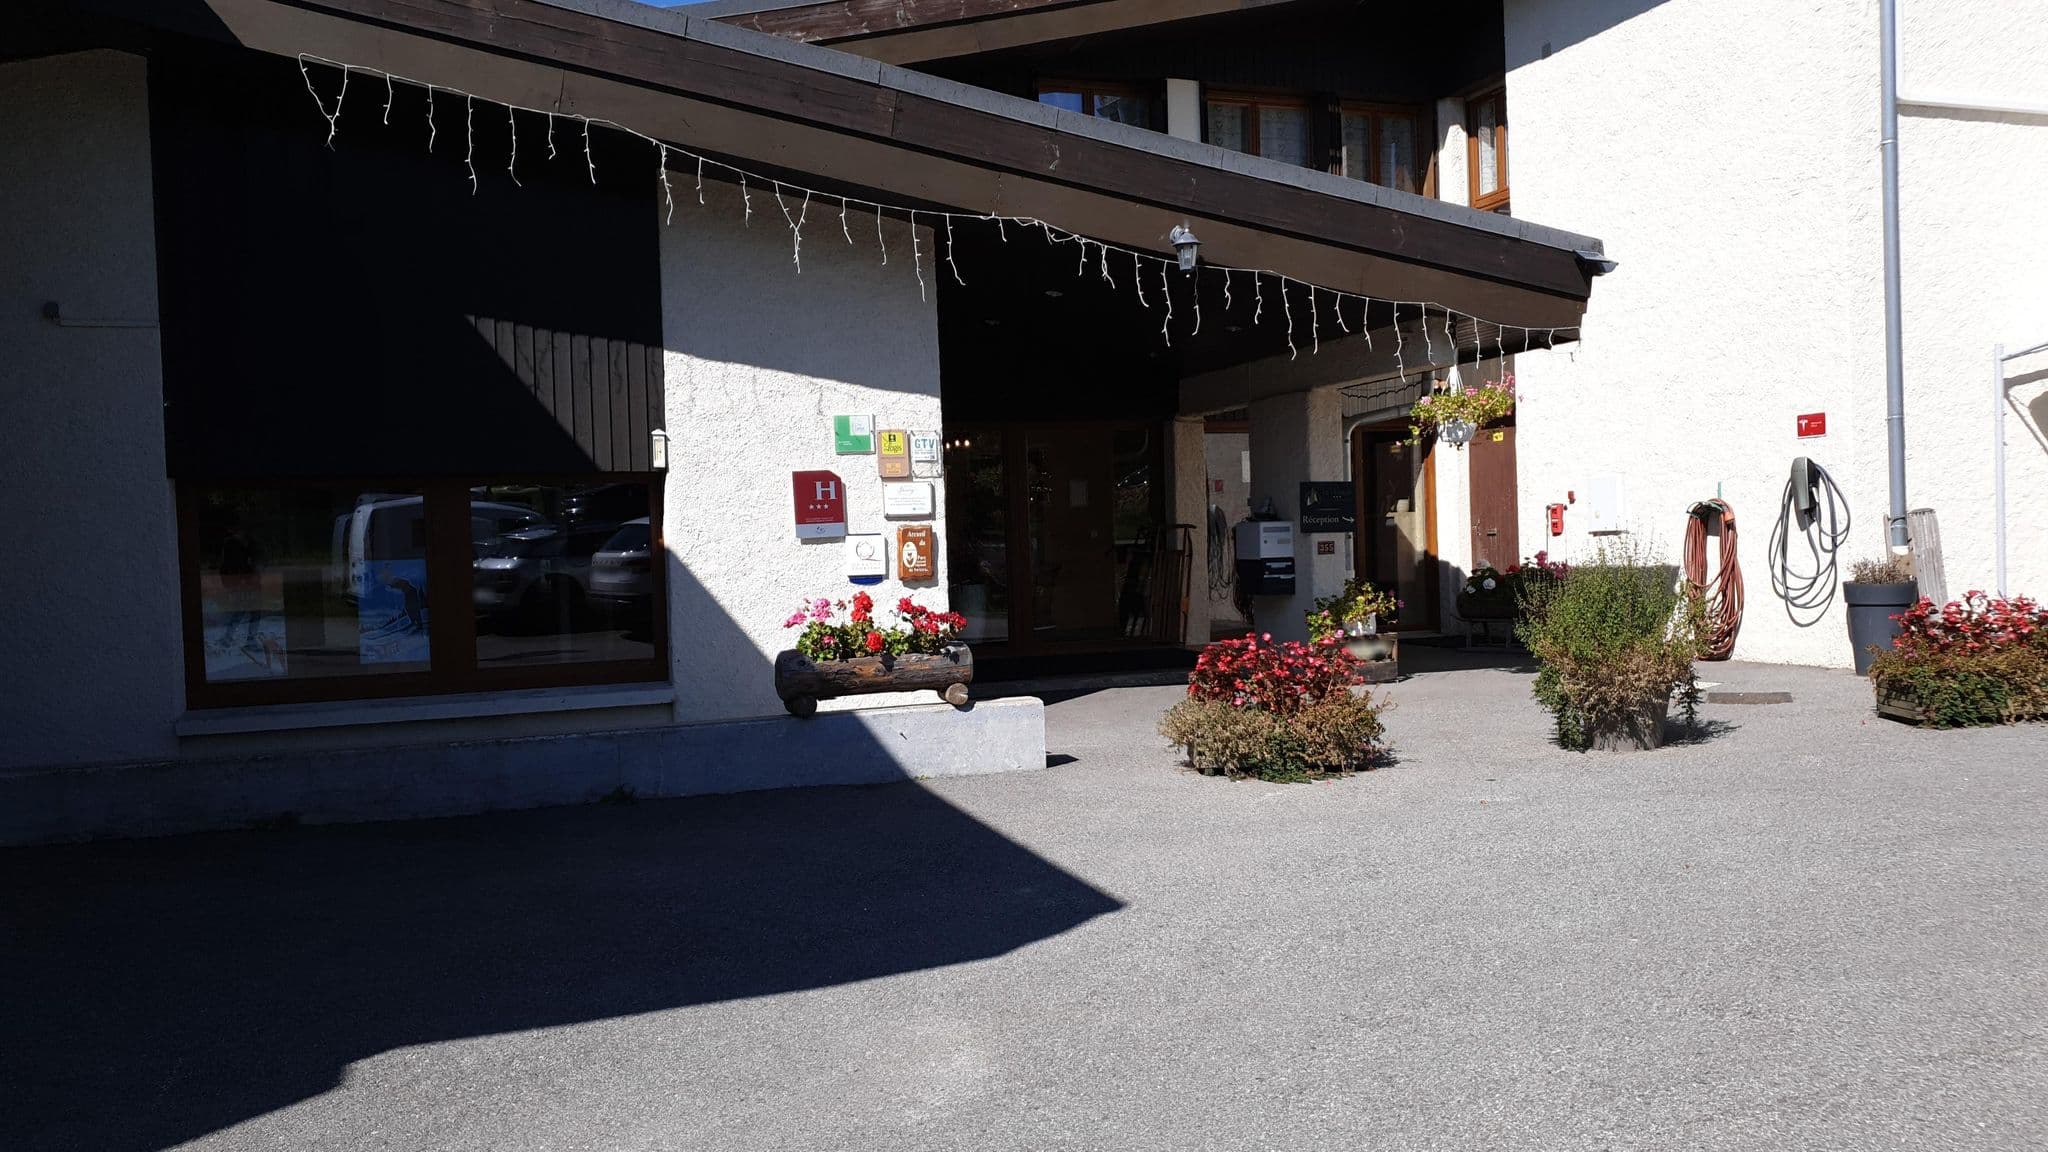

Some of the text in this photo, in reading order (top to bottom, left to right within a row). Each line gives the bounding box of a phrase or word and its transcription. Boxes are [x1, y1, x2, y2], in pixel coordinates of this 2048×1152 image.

[914, 438, 935, 449] GTV
[815, 480, 837, 500] H
[1302, 514, 1339, 526] Réception
[1319, 543, 1334, 553] 355
